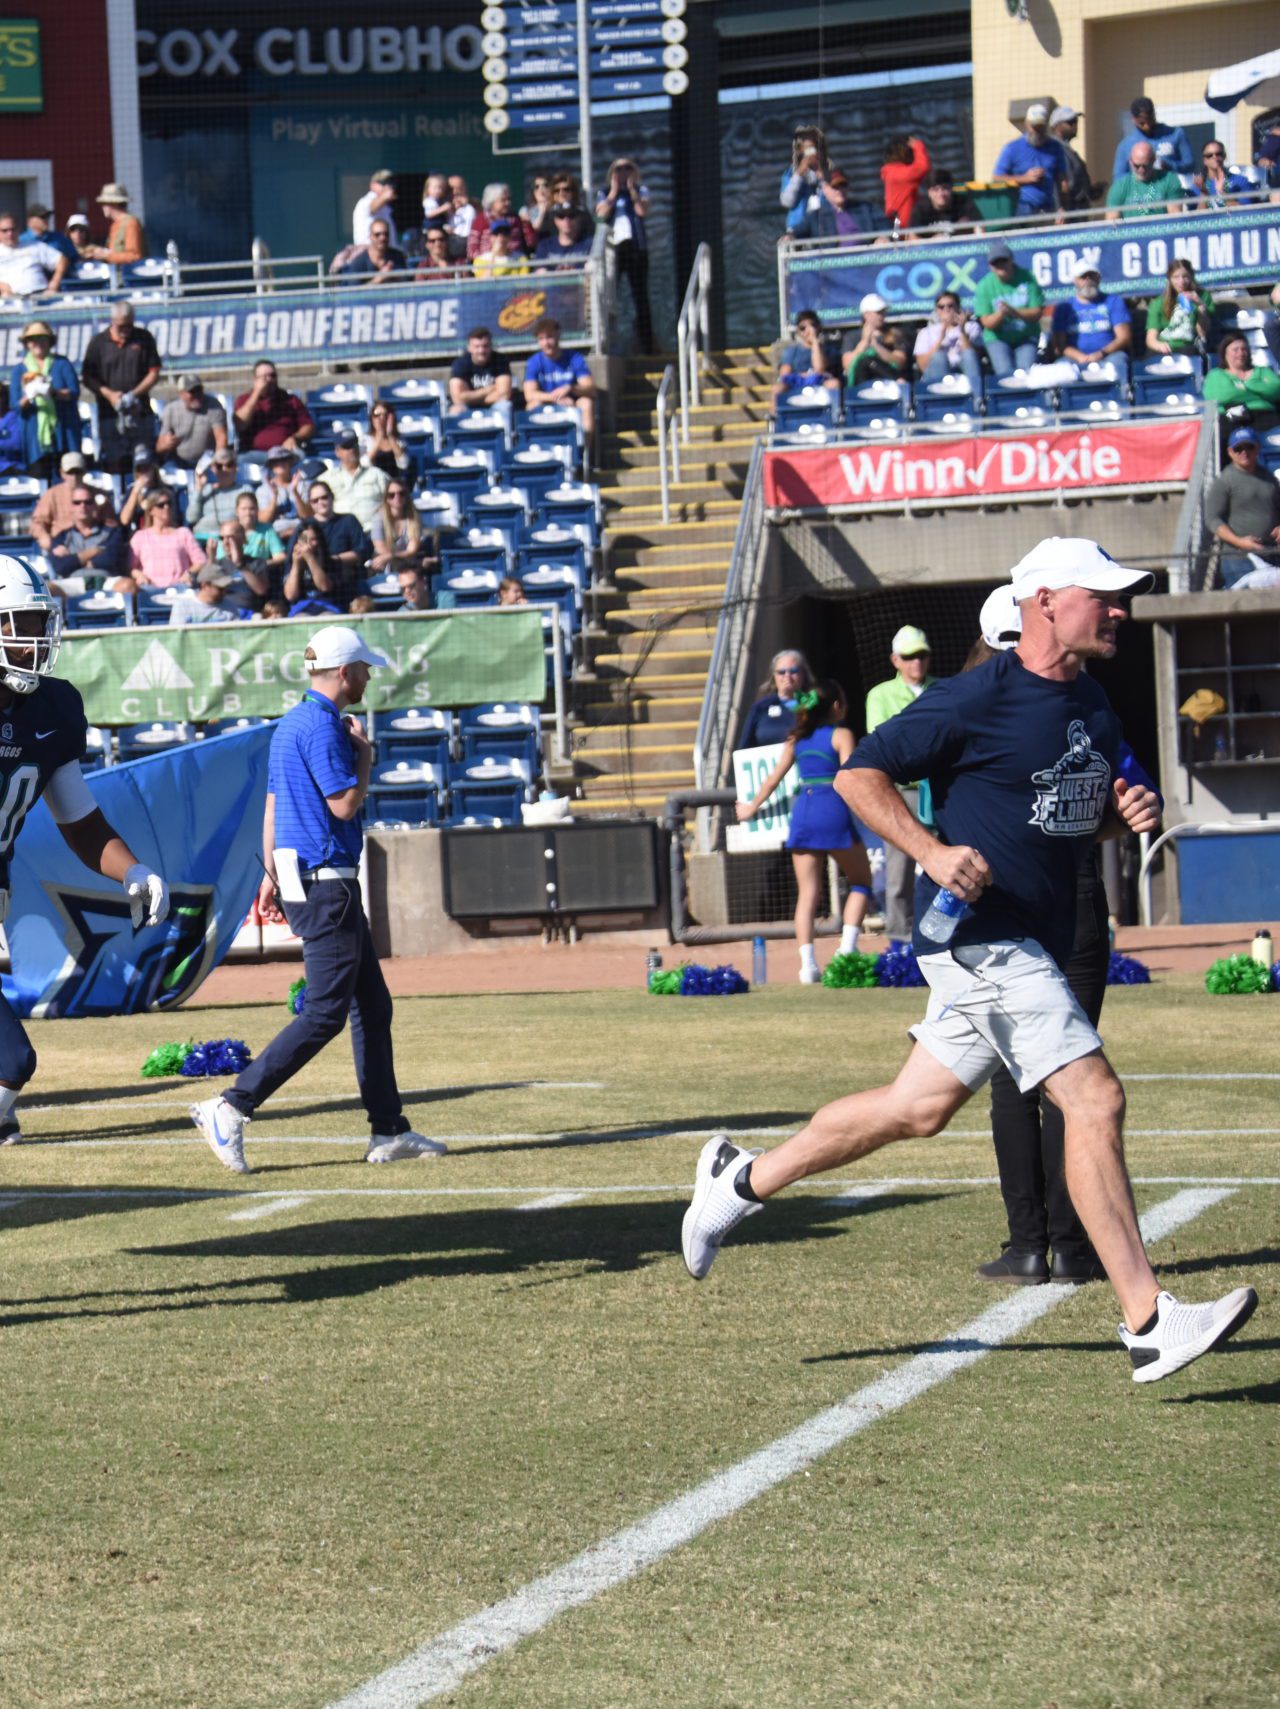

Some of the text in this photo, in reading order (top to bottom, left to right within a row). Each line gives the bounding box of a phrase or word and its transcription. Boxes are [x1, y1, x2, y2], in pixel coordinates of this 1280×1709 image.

[136, 24, 487, 76] COX CLUBHO
[271, 117, 320, 145] Play
[328, 114, 407, 139] Virtual
[876, 258, 977, 300] COX
[148, 313, 235, 361] OUTH
[243, 298, 459, 352] CONFERENCE
[838, 435, 1121, 495] Winn Dixie
[121, 693, 241, 718] CLUB
[1061, 778, 1104, 801] WEST
